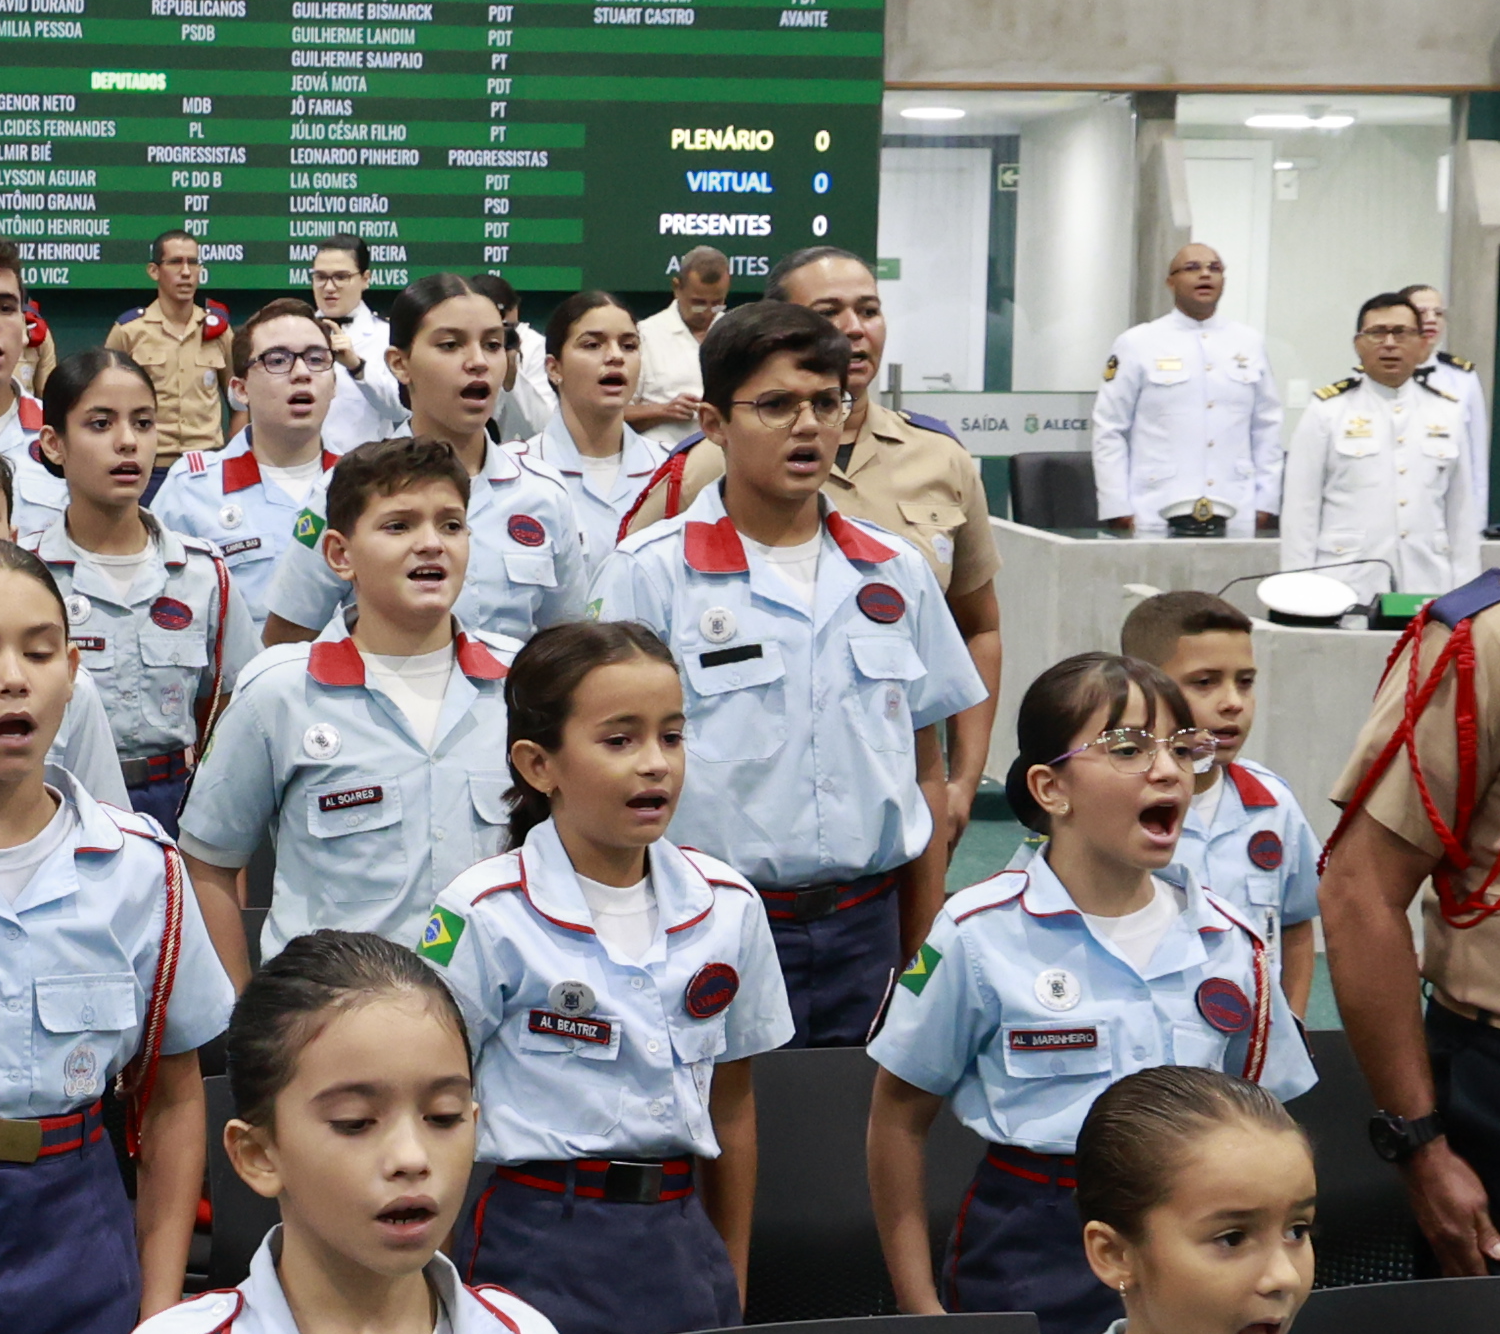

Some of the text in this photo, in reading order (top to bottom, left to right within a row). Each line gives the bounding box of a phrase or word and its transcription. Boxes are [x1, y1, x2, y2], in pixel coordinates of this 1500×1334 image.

[293, 2, 432, 20] GUILHERME BISMARCK
[594, 7, 694, 24] STUART CASTRO
[780, 11, 827, 27] AVANTE
[35, 21, 82, 37] PESSOA
[182, 24, 215, 41] PSDB
[293, 27, 414, 44] GUILHERME LANDIM
[292, 50, 422, 68] GUILHERME SAMPAIO
[92, 72, 166, 90] DEPUTADOS
[292, 71, 366, 91] JEOVÁ MOTA
[43, 95, 75, 111] NETO
[291, 95, 352, 115] JÔ FARIAS
[44, 120, 115, 136] FERNANDES
[291, 119, 406, 141] JÚLIO CÉSAR FILHO
[671, 125, 830, 152] PLENÁRIO 0
[32, 141, 51, 161] BIÉ
[291, 148, 419, 165] LEONARDO PINHEIRO
[48, 170, 96, 186] AGUIAR
[291, 173, 357, 188] LIA GOMES
[687, 172, 828, 193] VIRTUAL 0
[48, 194, 95, 210] GRANJA
[290, 192, 388, 213] LUCÍLVIO GIRÃO
[48, 219, 109, 236] HENRIQUE
[360, 221, 398, 237] FROTA
[660, 213, 827, 236] PRESENTES 0
[38, 243, 100, 261] HENRIQUE
[41, 268, 68, 283] VICZ
[962, 415, 1009, 434] SAÍDA
[1043, 417, 1088, 434] ALECE
[324, 788, 376, 808] AL SOARES
[540, 1016, 598, 1038] AL BEATRIZ
[1013, 1031, 1096, 1046] AL MARINHEIRO
